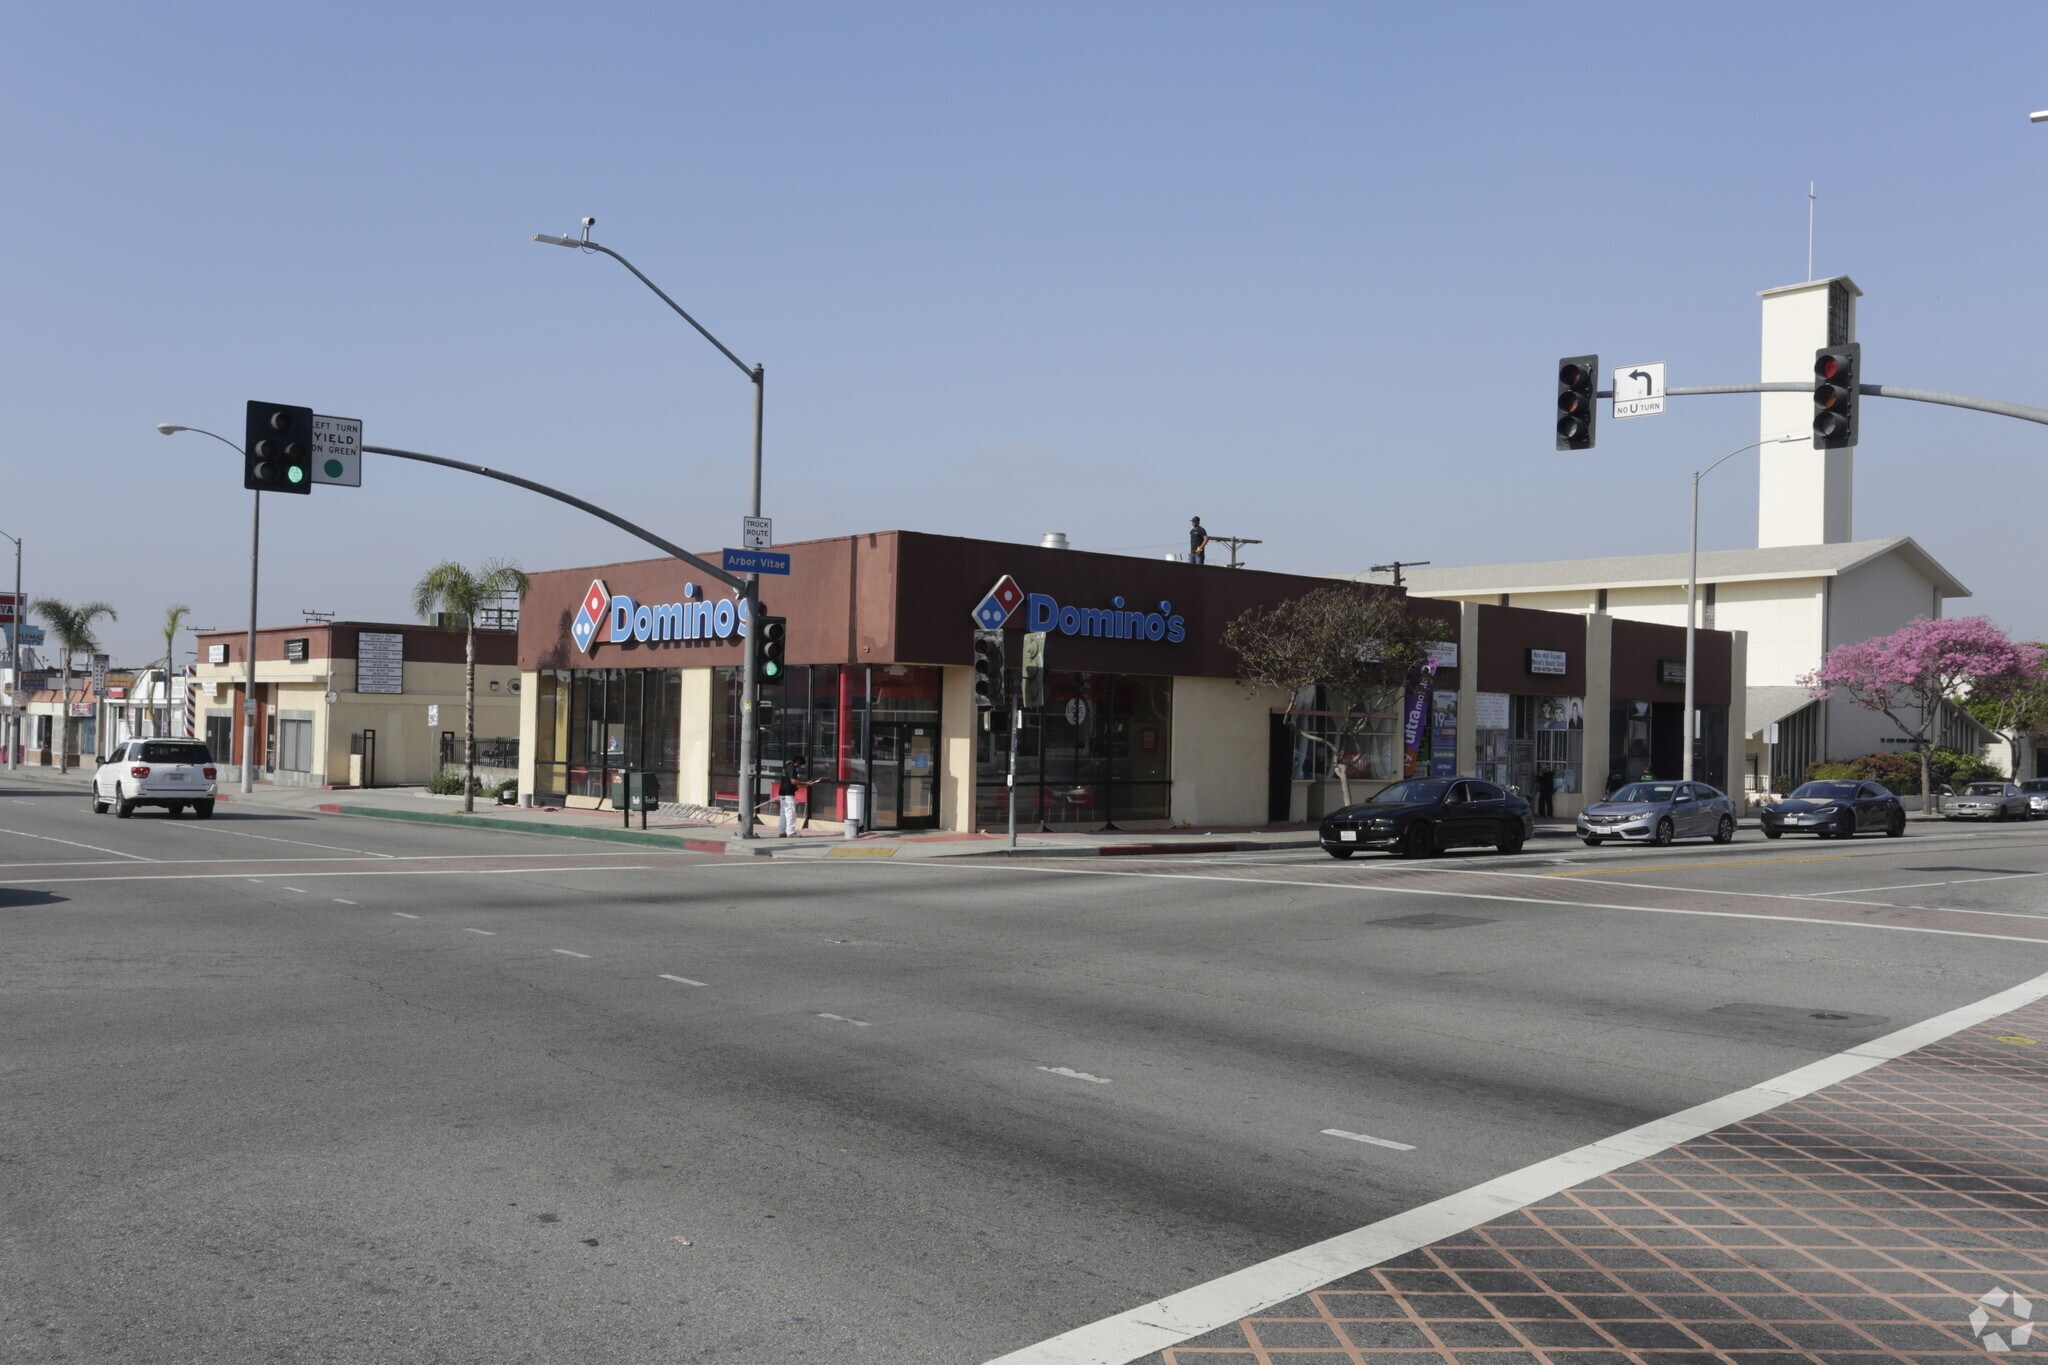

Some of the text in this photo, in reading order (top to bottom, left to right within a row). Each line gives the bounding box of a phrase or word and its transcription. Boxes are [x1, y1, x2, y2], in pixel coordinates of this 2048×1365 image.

[1617, 402, 1660, 414] NO U TURN
[336, 423, 358, 433] TURN
[313, 431, 354, 445] YIELD
[312, 444, 357, 456] ON GREEN
[746, 520, 769, 528] TRUCK
[746, 529, 769, 537] ROUTE
[728, 555, 786, 569] Arbor Vitae
[1028, 592, 1186, 643] Domino's
[1405, 708, 1421, 744] ultra
